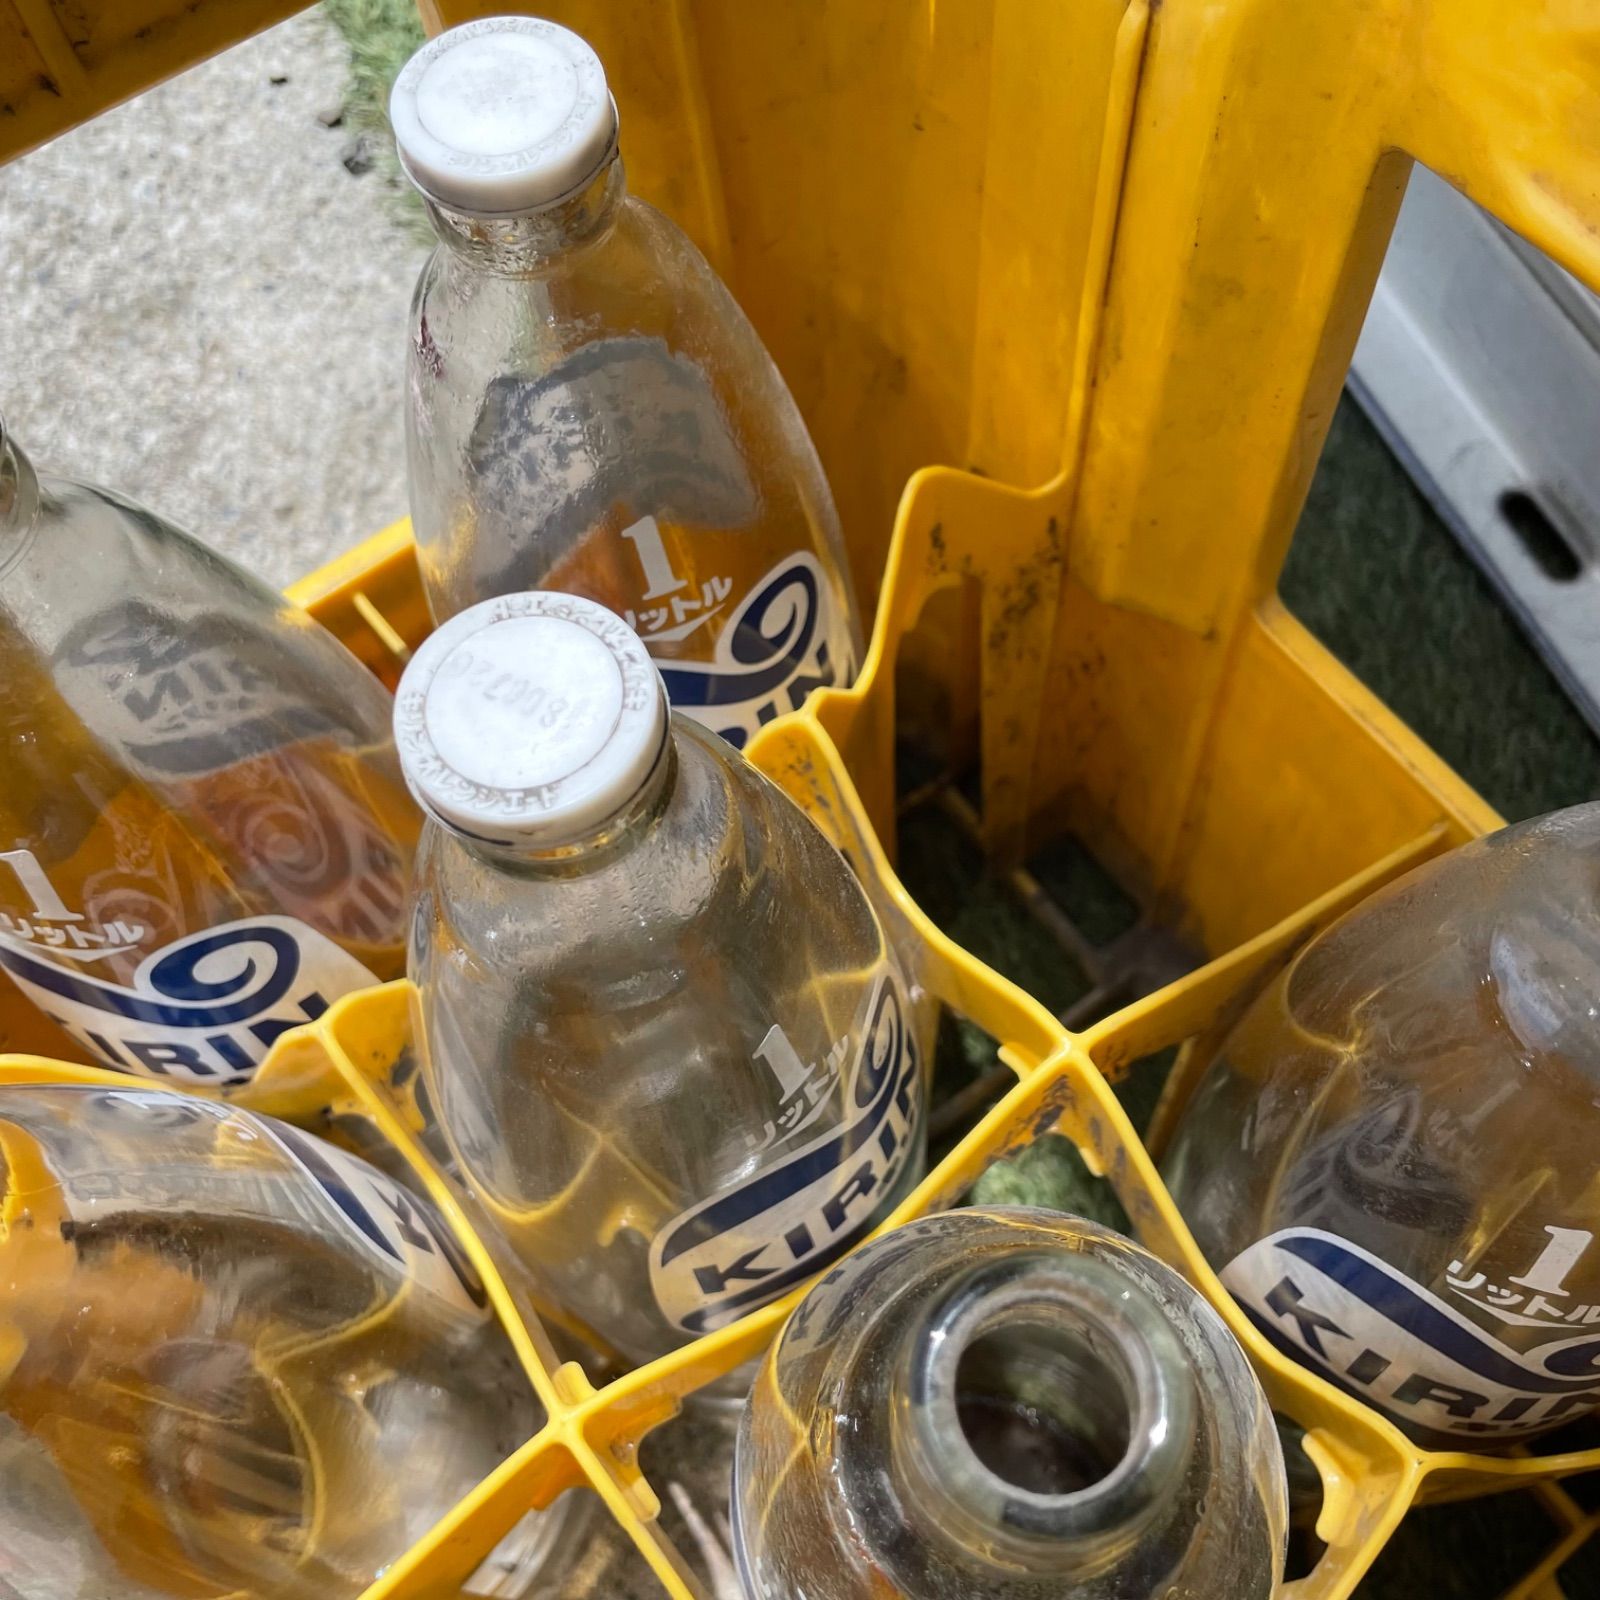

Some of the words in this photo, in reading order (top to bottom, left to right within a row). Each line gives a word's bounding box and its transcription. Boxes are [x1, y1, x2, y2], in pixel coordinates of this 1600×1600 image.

[621, 515, 688, 600] 1
[0, 849, 85, 920] 1
[47, 991, 330, 1074] IRIN
[752, 1024, 816, 1105] 1
[744, 1034, 849, 1149] リットル
[693, 1028, 917, 1294] KIRIN
[1508, 1225, 1593, 1297] 1
